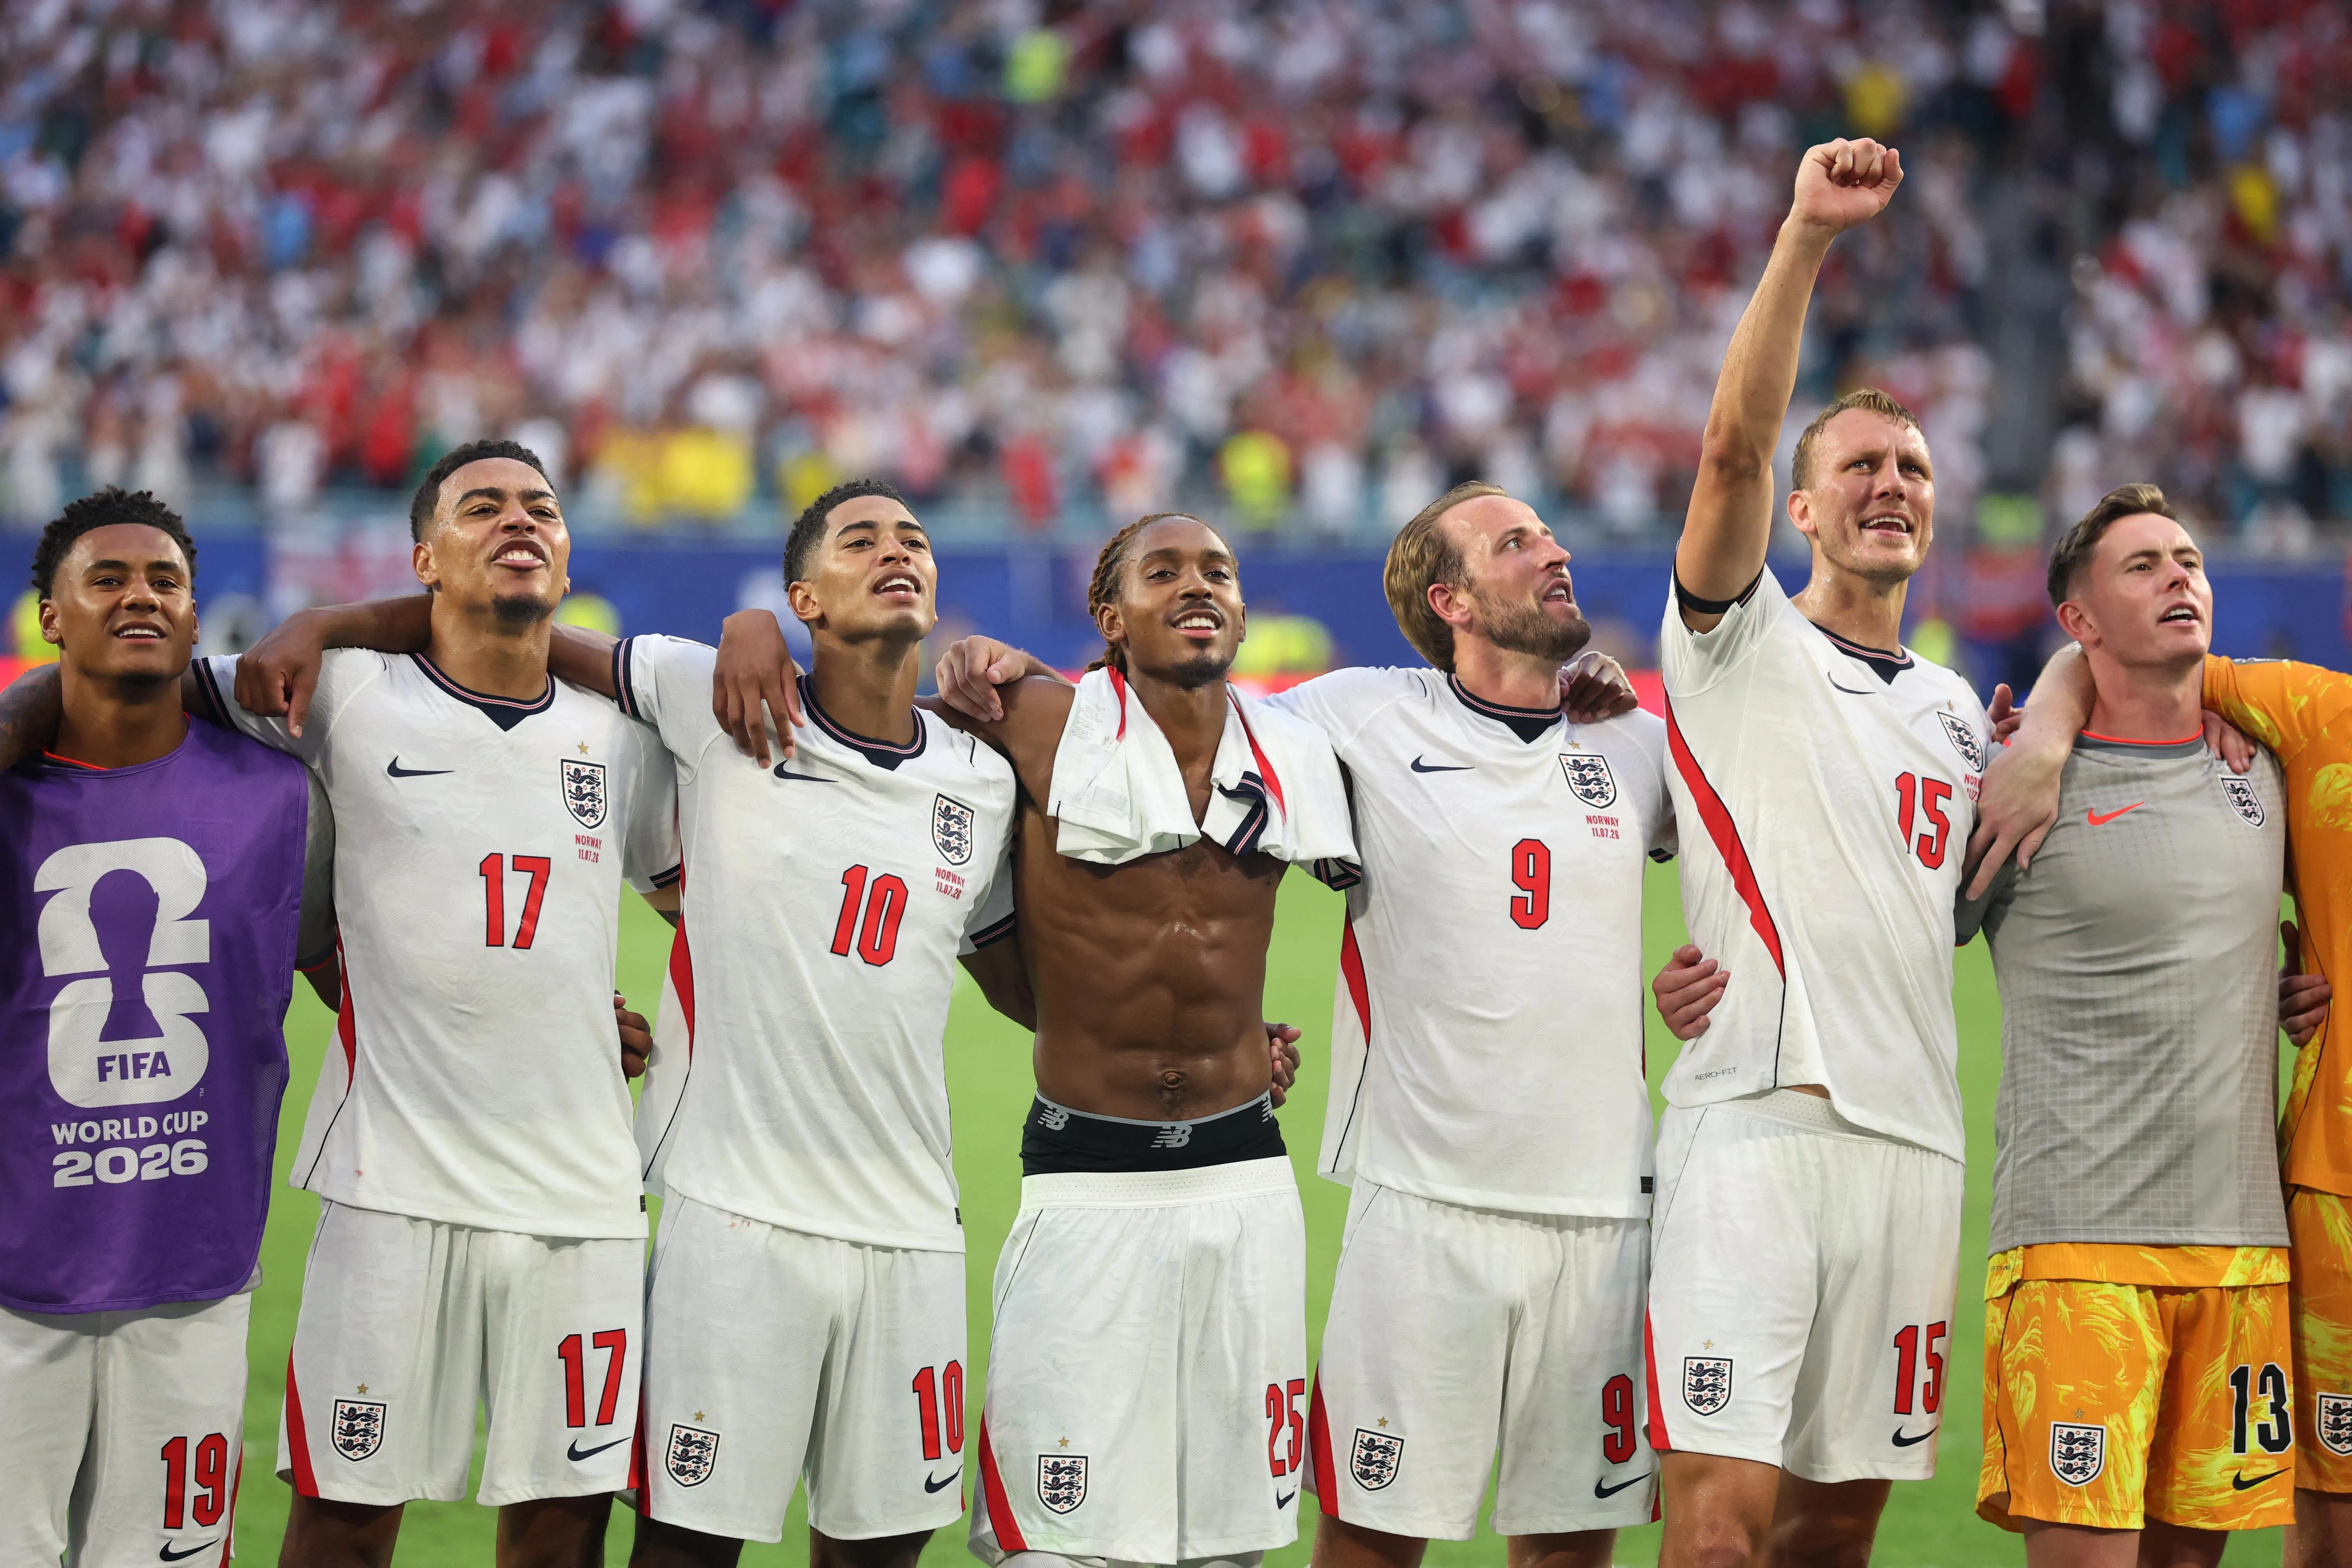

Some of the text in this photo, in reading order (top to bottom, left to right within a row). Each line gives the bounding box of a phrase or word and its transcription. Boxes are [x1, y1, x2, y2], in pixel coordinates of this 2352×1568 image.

[575, 834, 602, 849] NORWAY
[1586, 815, 1619, 827] NORWAY
[1592, 828, 1619, 839] 11.07.26
[1895, 771, 1952, 870] 15
[579, 849, 599, 863] 11.07.26
[935, 867, 965, 887] NORWAY
[936, 881, 962, 900] 11.07.26
[1510, 838, 1550, 929] 9
[480, 853, 551, 949] 17
[830, 864, 909, 967] 10
[97, 1051, 171, 1082] FIFA
[200, 1088, 204, 1098] TM
[1695, 1067, 1737, 1081] AERO-FIT
[51, 1111, 209, 1145] WORLD CUP
[53, 1139, 208, 1188] 2026
[558, 1328, 627, 1428] 17
[1894, 1321, 1946, 1415] 15
[912, 1360, 964, 1461] 10
[1265, 1378, 1305, 1477] 25
[1602, 1374, 1637, 1465] 9
[2229, 1361, 2293, 1455] 13
[161, 1433, 228, 1529] 19
